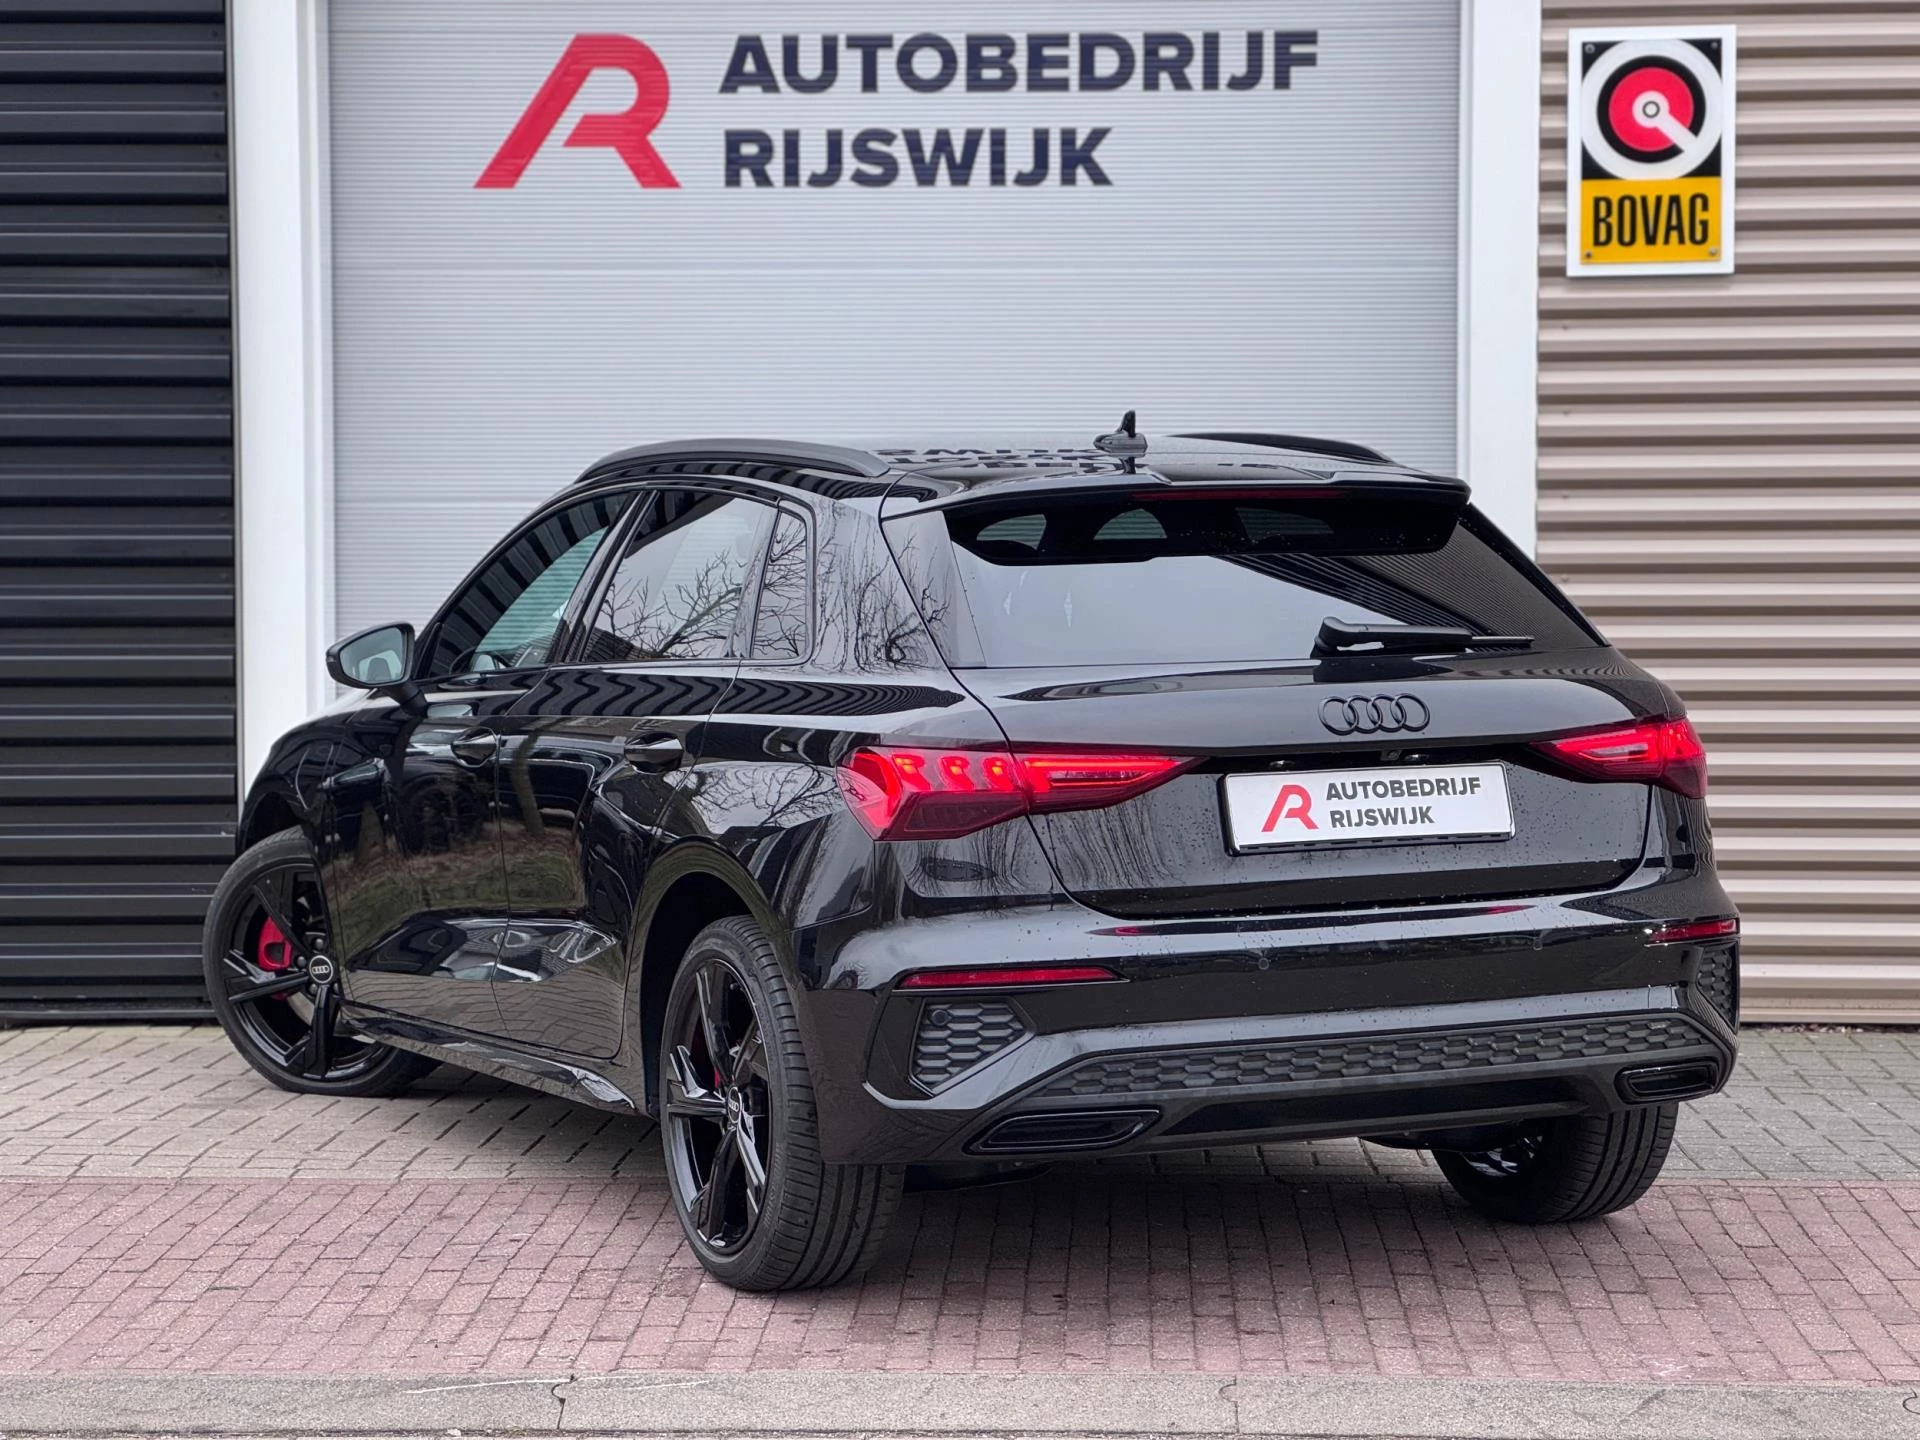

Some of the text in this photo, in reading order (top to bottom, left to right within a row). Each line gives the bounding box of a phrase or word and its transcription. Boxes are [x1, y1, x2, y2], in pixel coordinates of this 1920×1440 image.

[719, 30, 1319, 94] AUTOBEDRIJF
[724, 127, 1113, 188] RIJSWIJK
[1593, 193, 1709, 248] BOVAG
[1326, 776, 1481, 801] AUTOBEDRIJF
[1330, 806, 1435, 828] RIJSWIJK
